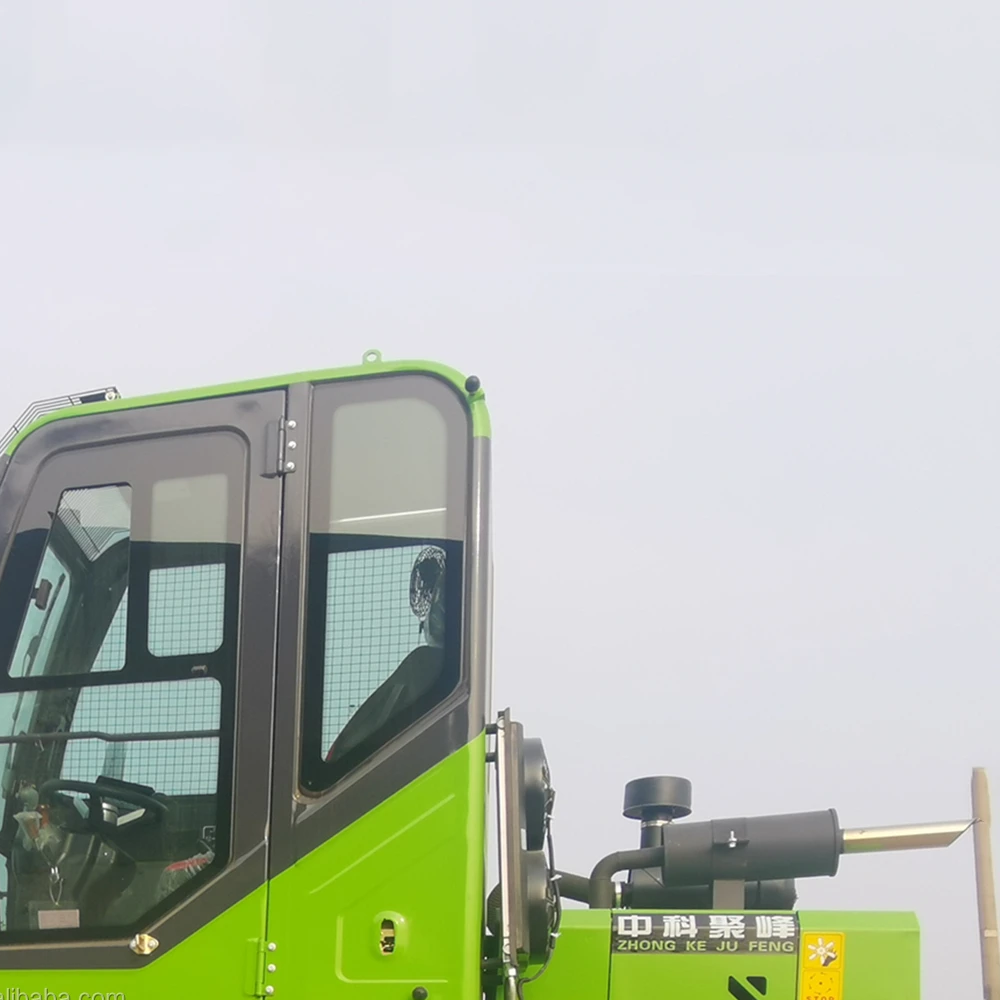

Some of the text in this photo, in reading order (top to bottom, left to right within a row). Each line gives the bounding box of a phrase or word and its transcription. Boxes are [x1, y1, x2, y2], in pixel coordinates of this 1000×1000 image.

[616, 914, 796, 940] 中科聚峰
[616, 939, 795, 953] ZHONG KE JU FENG
